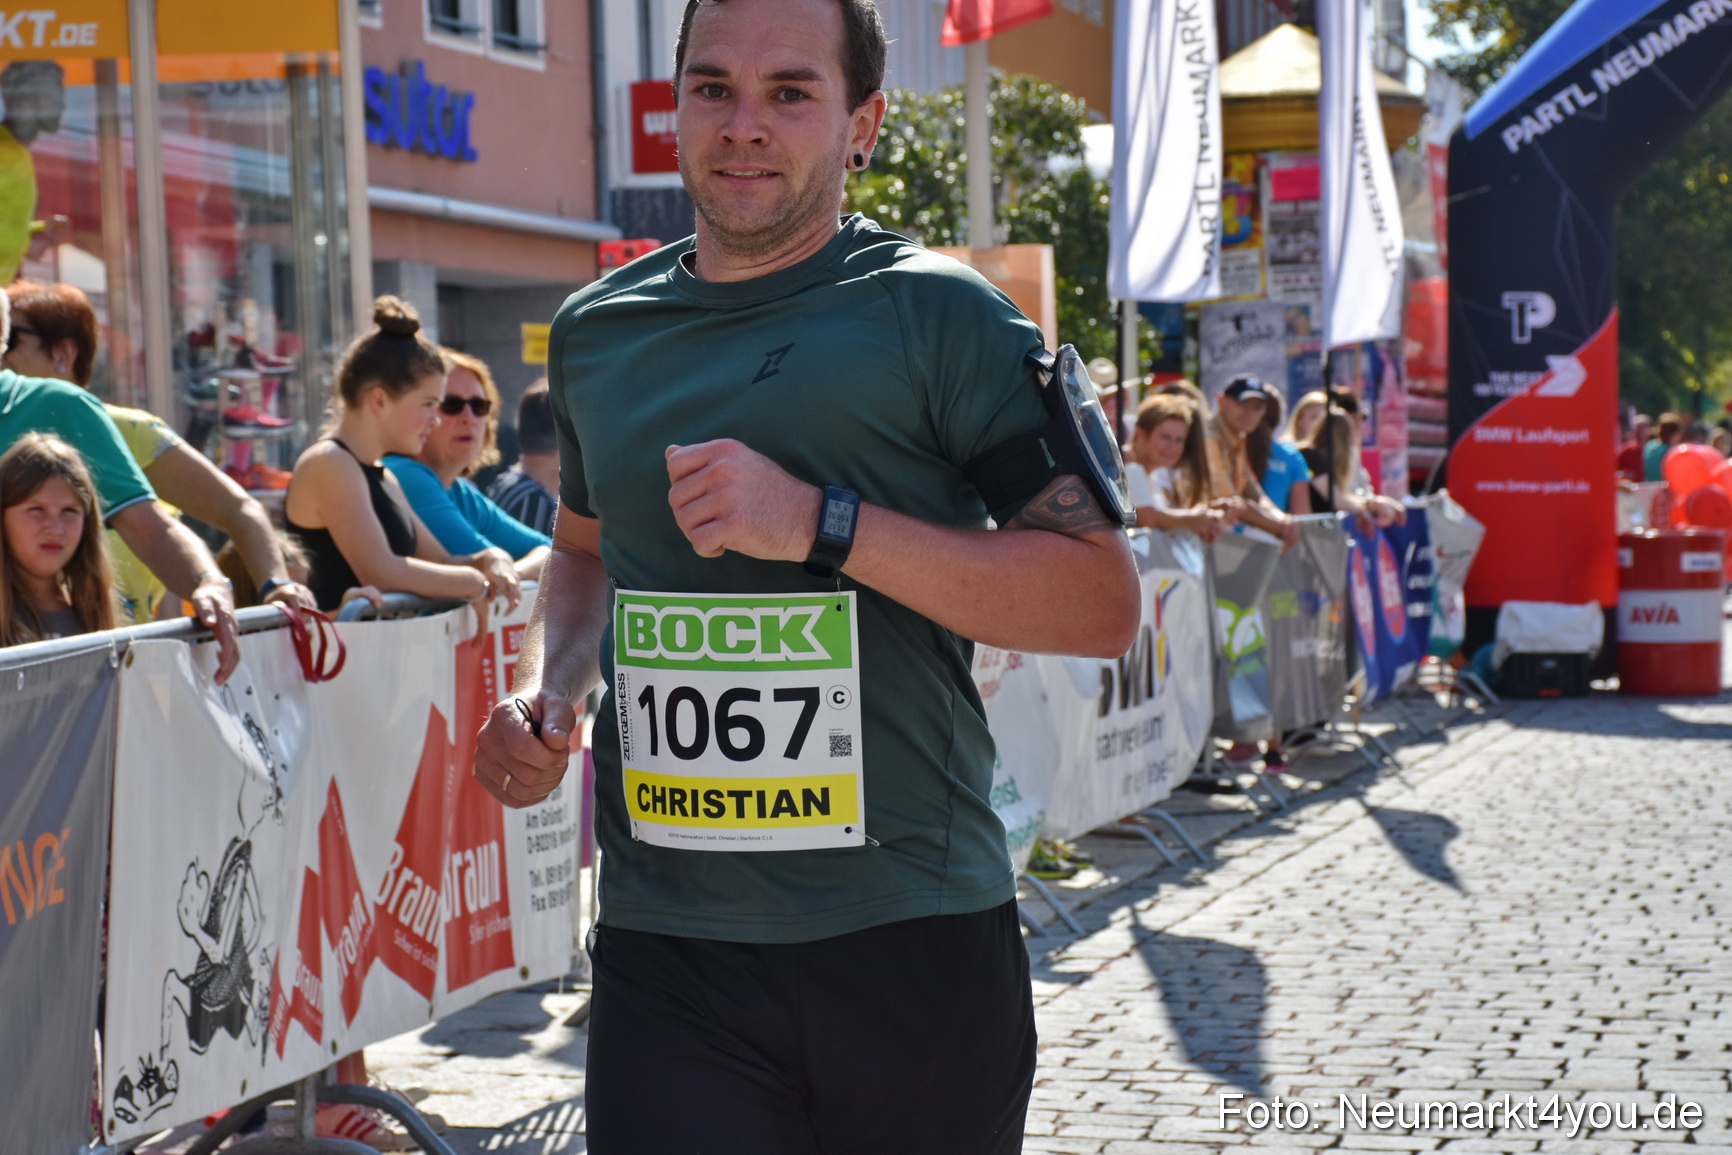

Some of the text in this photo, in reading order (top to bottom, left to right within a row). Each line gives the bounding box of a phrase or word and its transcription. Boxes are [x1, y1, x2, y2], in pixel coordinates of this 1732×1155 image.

[1501, 83, 1598, 153] PARTL
[1474, 426, 1589, 445] BMW Laufsport
[625, 605, 831, 661] BOCK
[832, 691, 846, 704] C
[637, 685, 820, 761] 1067
[637, 783, 831, 818] CHRISTIAN
